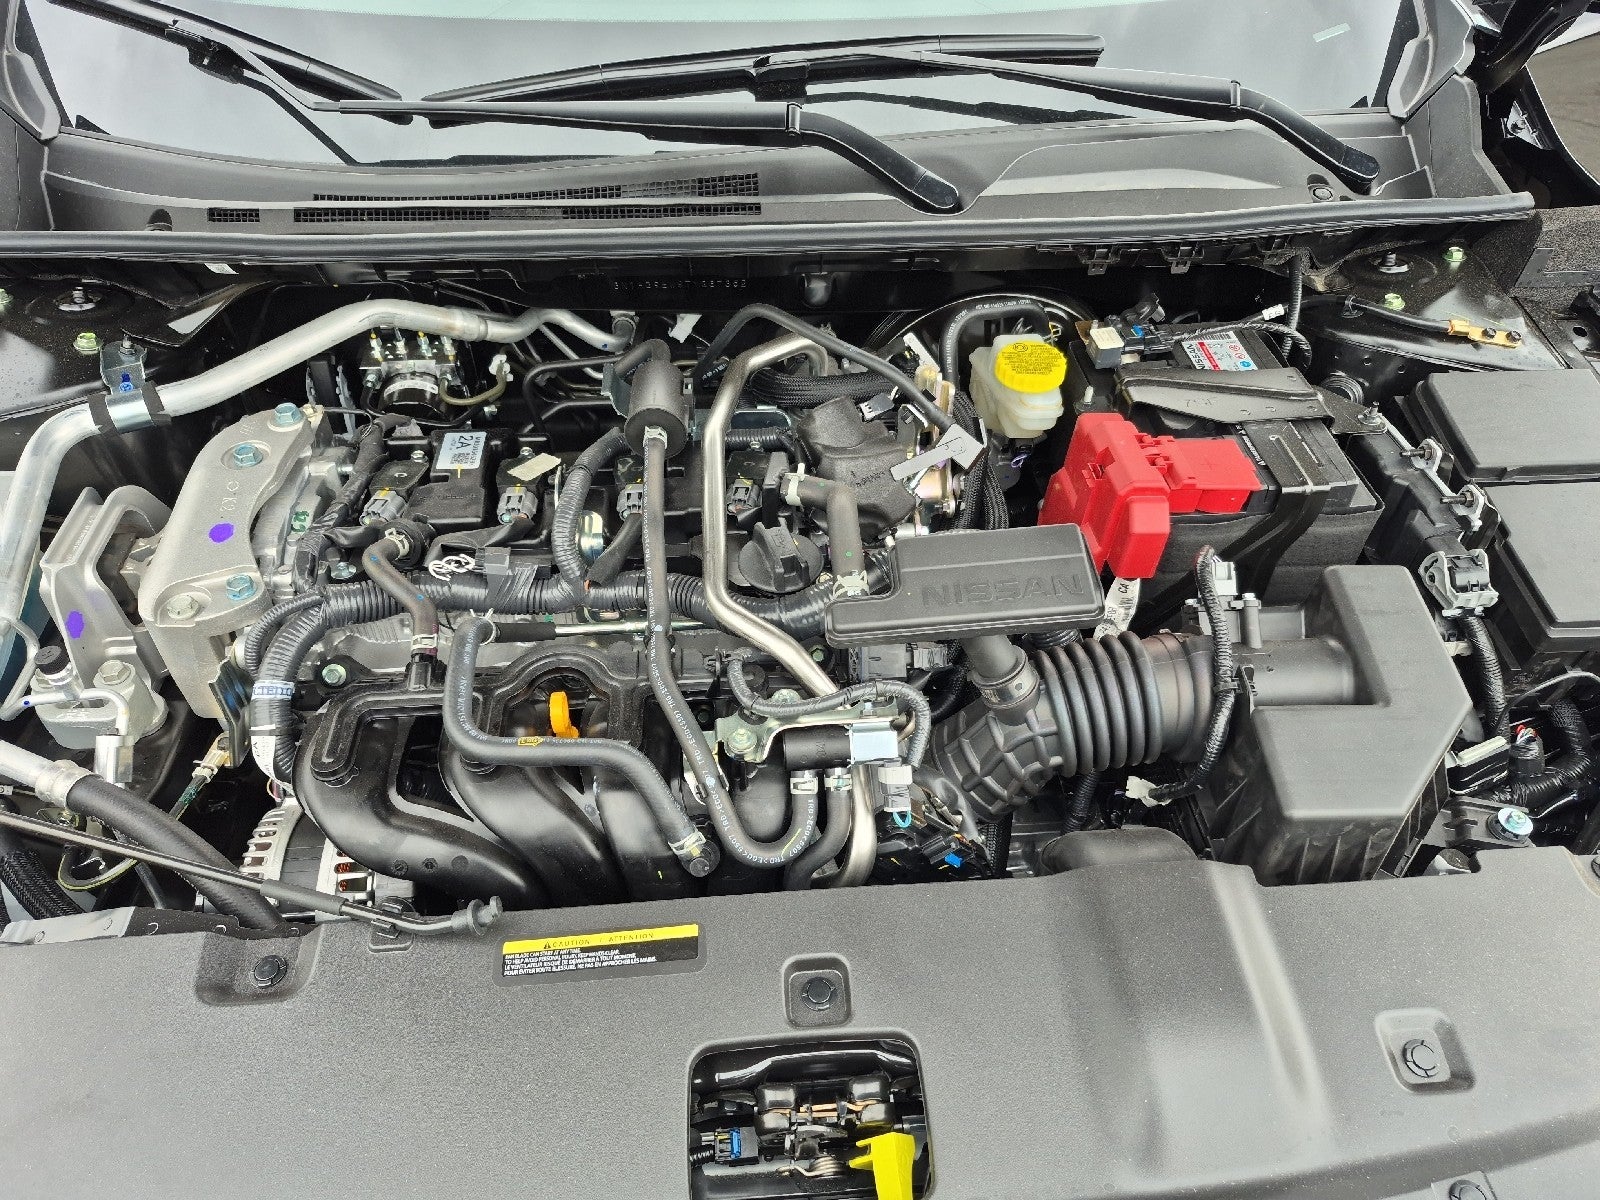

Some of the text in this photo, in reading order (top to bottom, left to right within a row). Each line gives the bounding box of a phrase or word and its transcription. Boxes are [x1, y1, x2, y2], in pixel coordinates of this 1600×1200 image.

[456, 436, 474, 450] 2A
[921, 574, 1084, 606] NISSAN
[608, 932, 654, 942] ATTENTION
